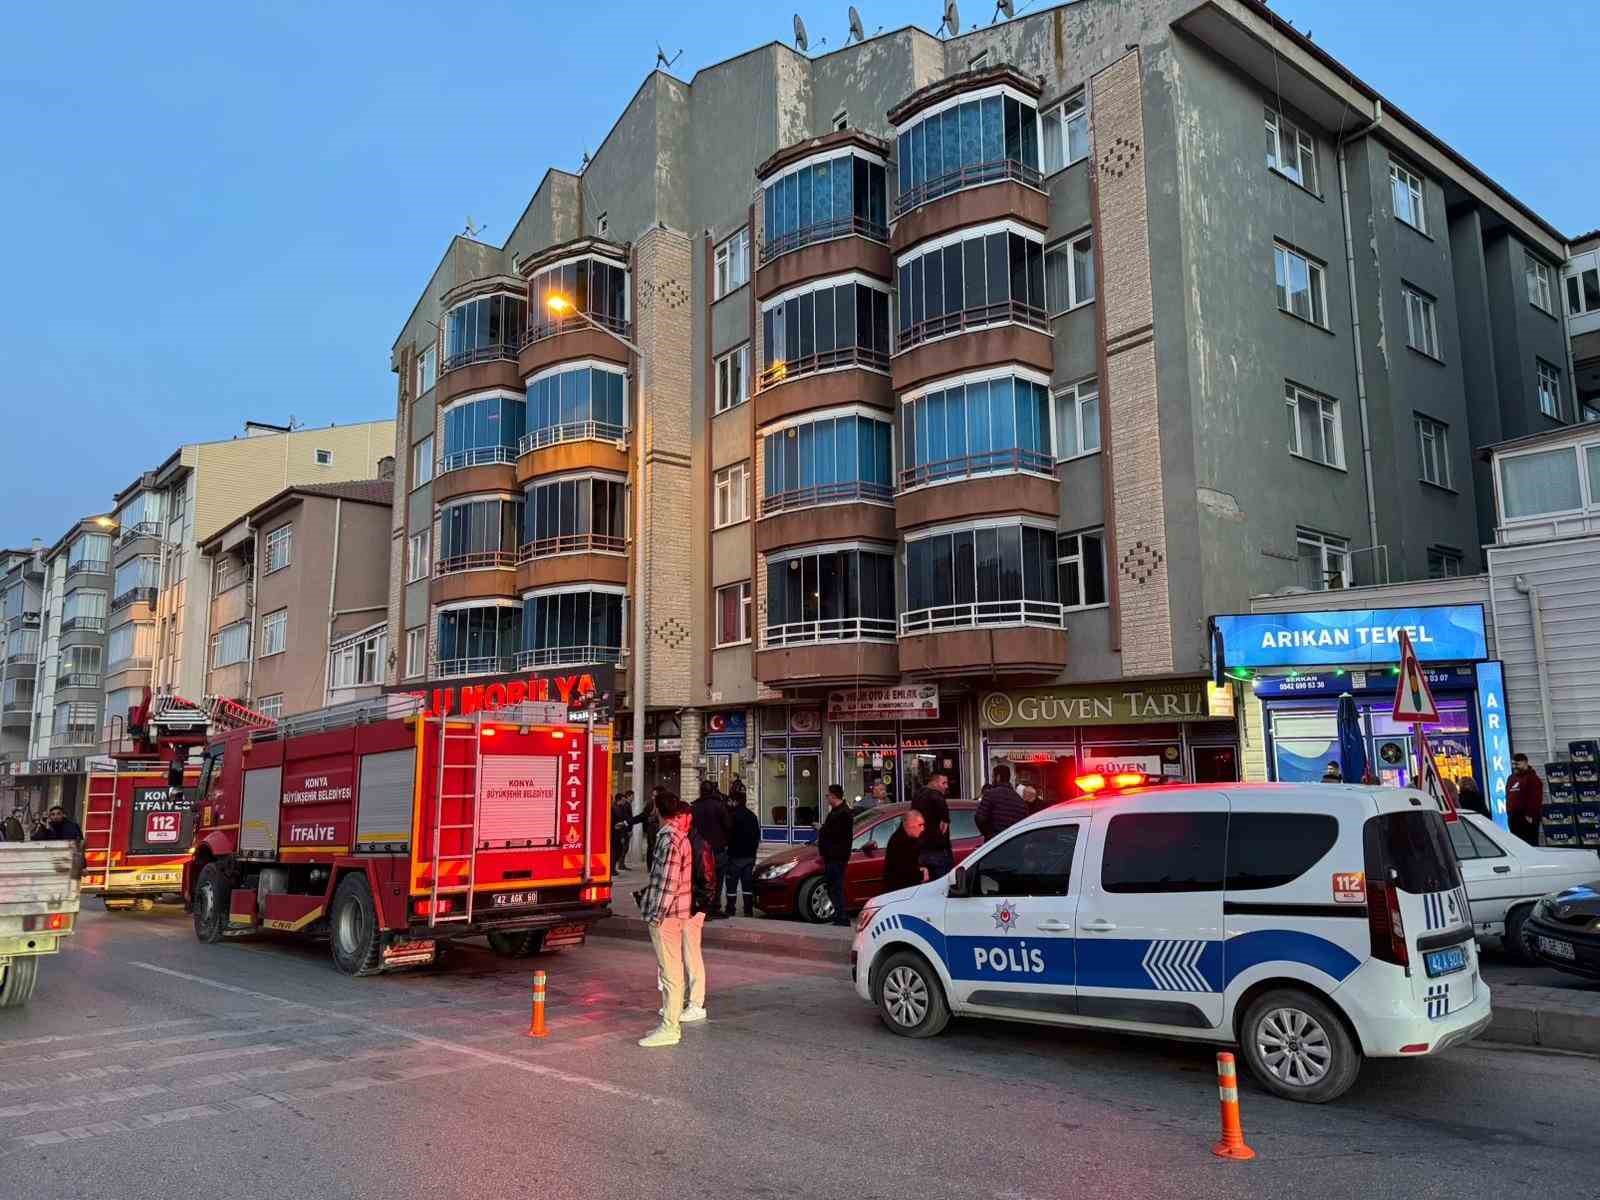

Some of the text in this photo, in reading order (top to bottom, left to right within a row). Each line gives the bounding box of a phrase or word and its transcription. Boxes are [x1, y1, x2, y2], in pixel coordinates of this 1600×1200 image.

[1261, 625, 1433, 648] ARIKAN TEKEL
[461, 672, 597, 717] MOBİLYA
[1017, 695, 1113, 720] GÜVEN
[1486, 693, 1508, 816] ARIKAN
[1095, 762, 1147, 774] GÜVEN
[305, 776, 328, 789] KONYA
[508, 778, 535, 787] KONYA
[565, 738, 582, 823] İTFAİYE
[318, 784, 352, 800] BELEDİYESİ
[152, 815, 176, 831] 112
[290, 823, 335, 842] İTFAİYE
[1336, 875, 1361, 891] 112
[974, 941, 1045, 973] POLİS
